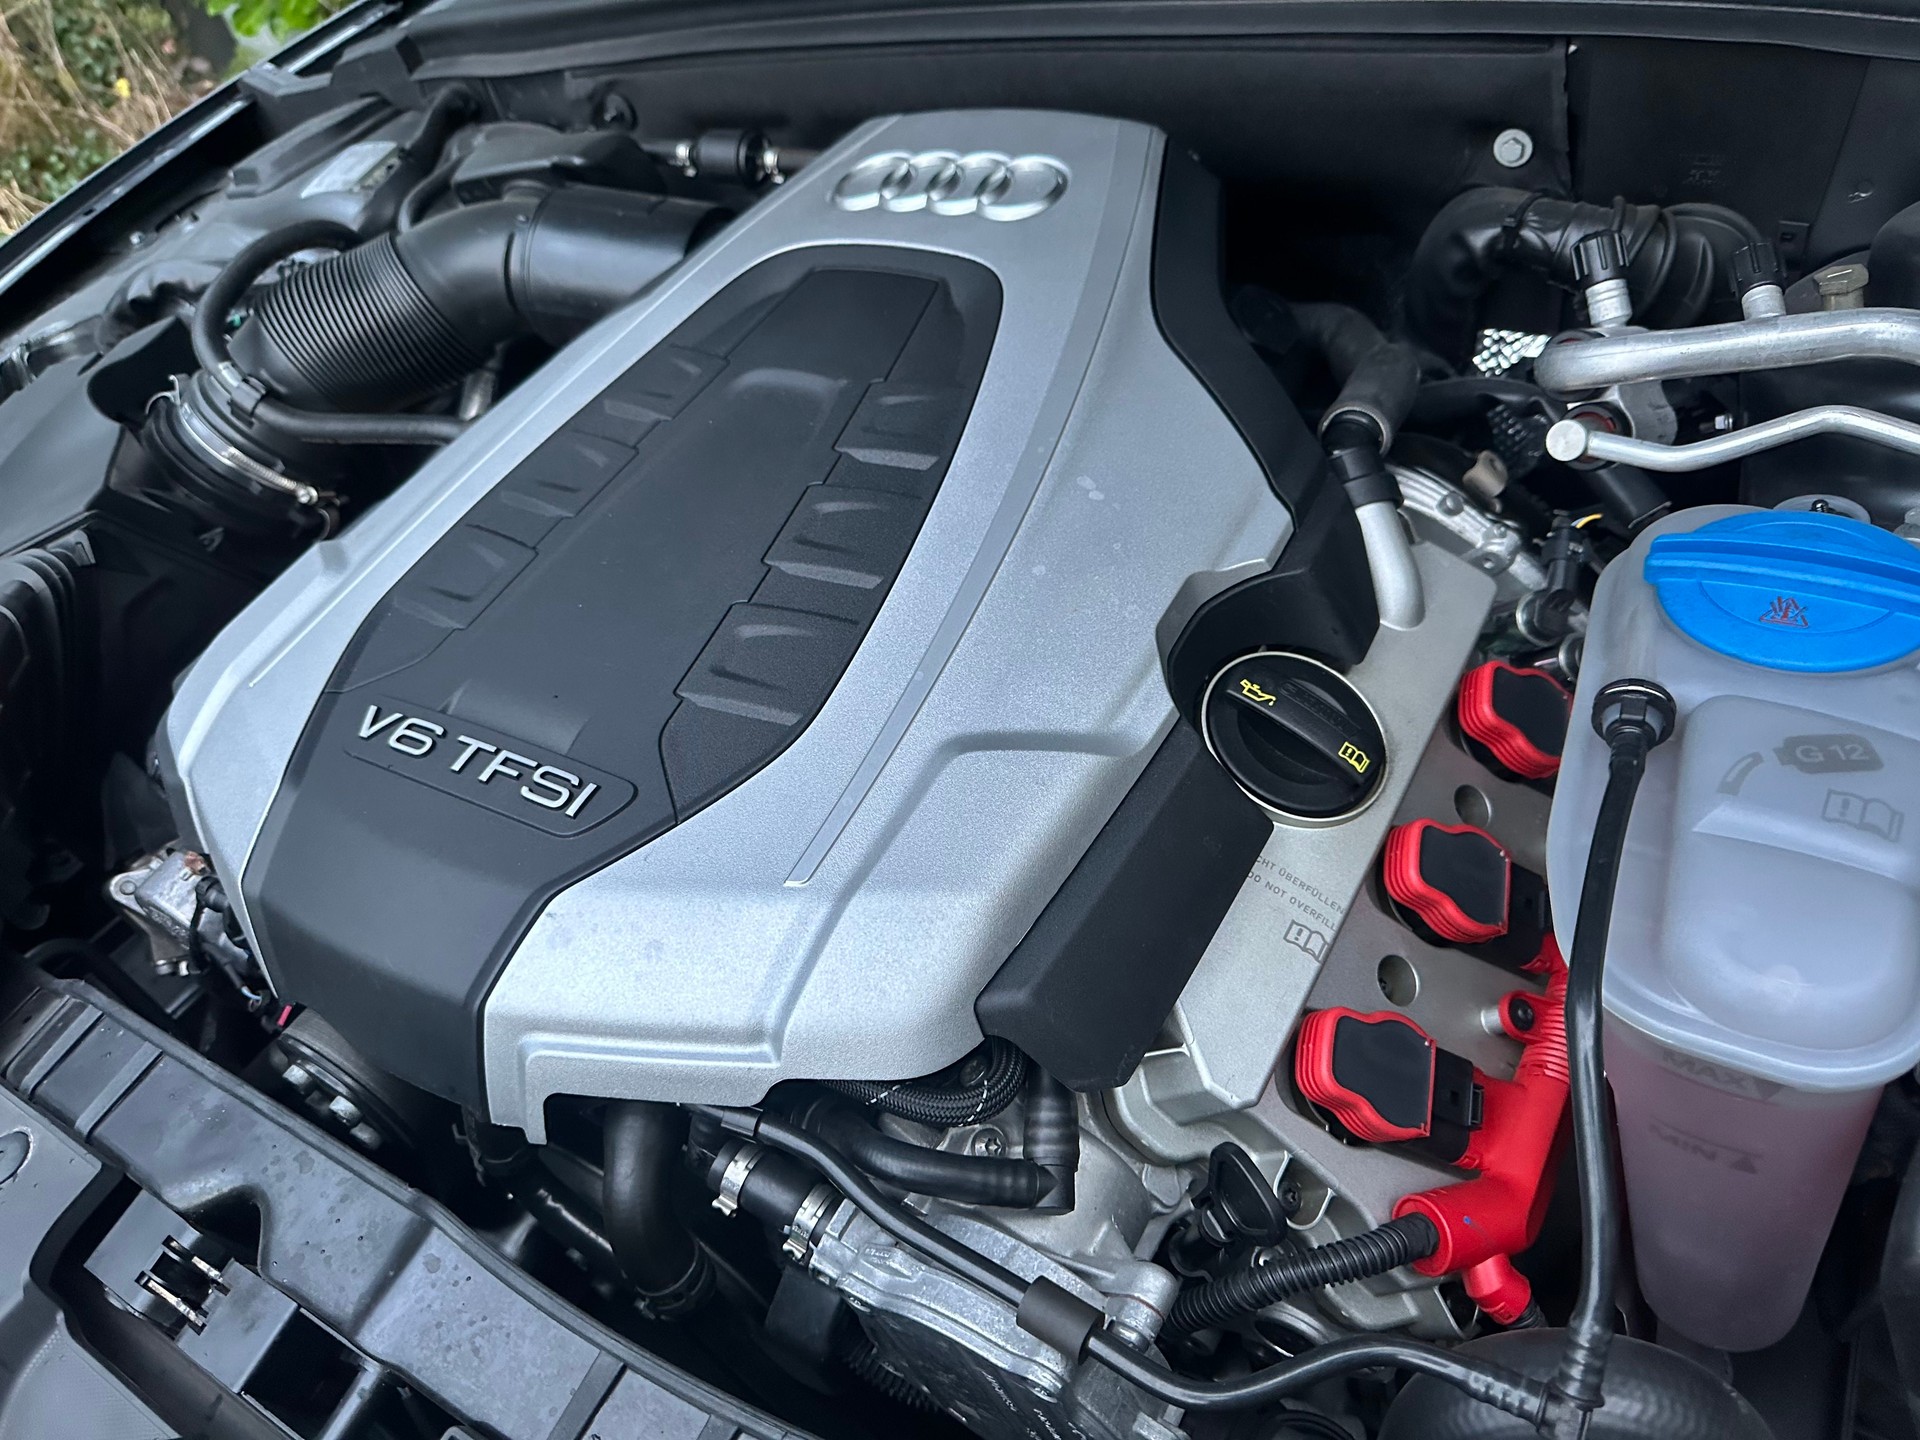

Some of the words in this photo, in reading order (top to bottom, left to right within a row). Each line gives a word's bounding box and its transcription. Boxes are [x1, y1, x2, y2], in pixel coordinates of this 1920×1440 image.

[358, 704, 445, 756] V6
[449, 734, 598, 818] TFSI
[1247, 871, 1262, 883] DO
[1264, 880, 1288, 899] NOT
[1289, 896, 1337, 933] OVERFILL
[1256, 855, 1276, 870] CHT
[1278, 866, 1345, 915] ÜBERFÜLLEN
